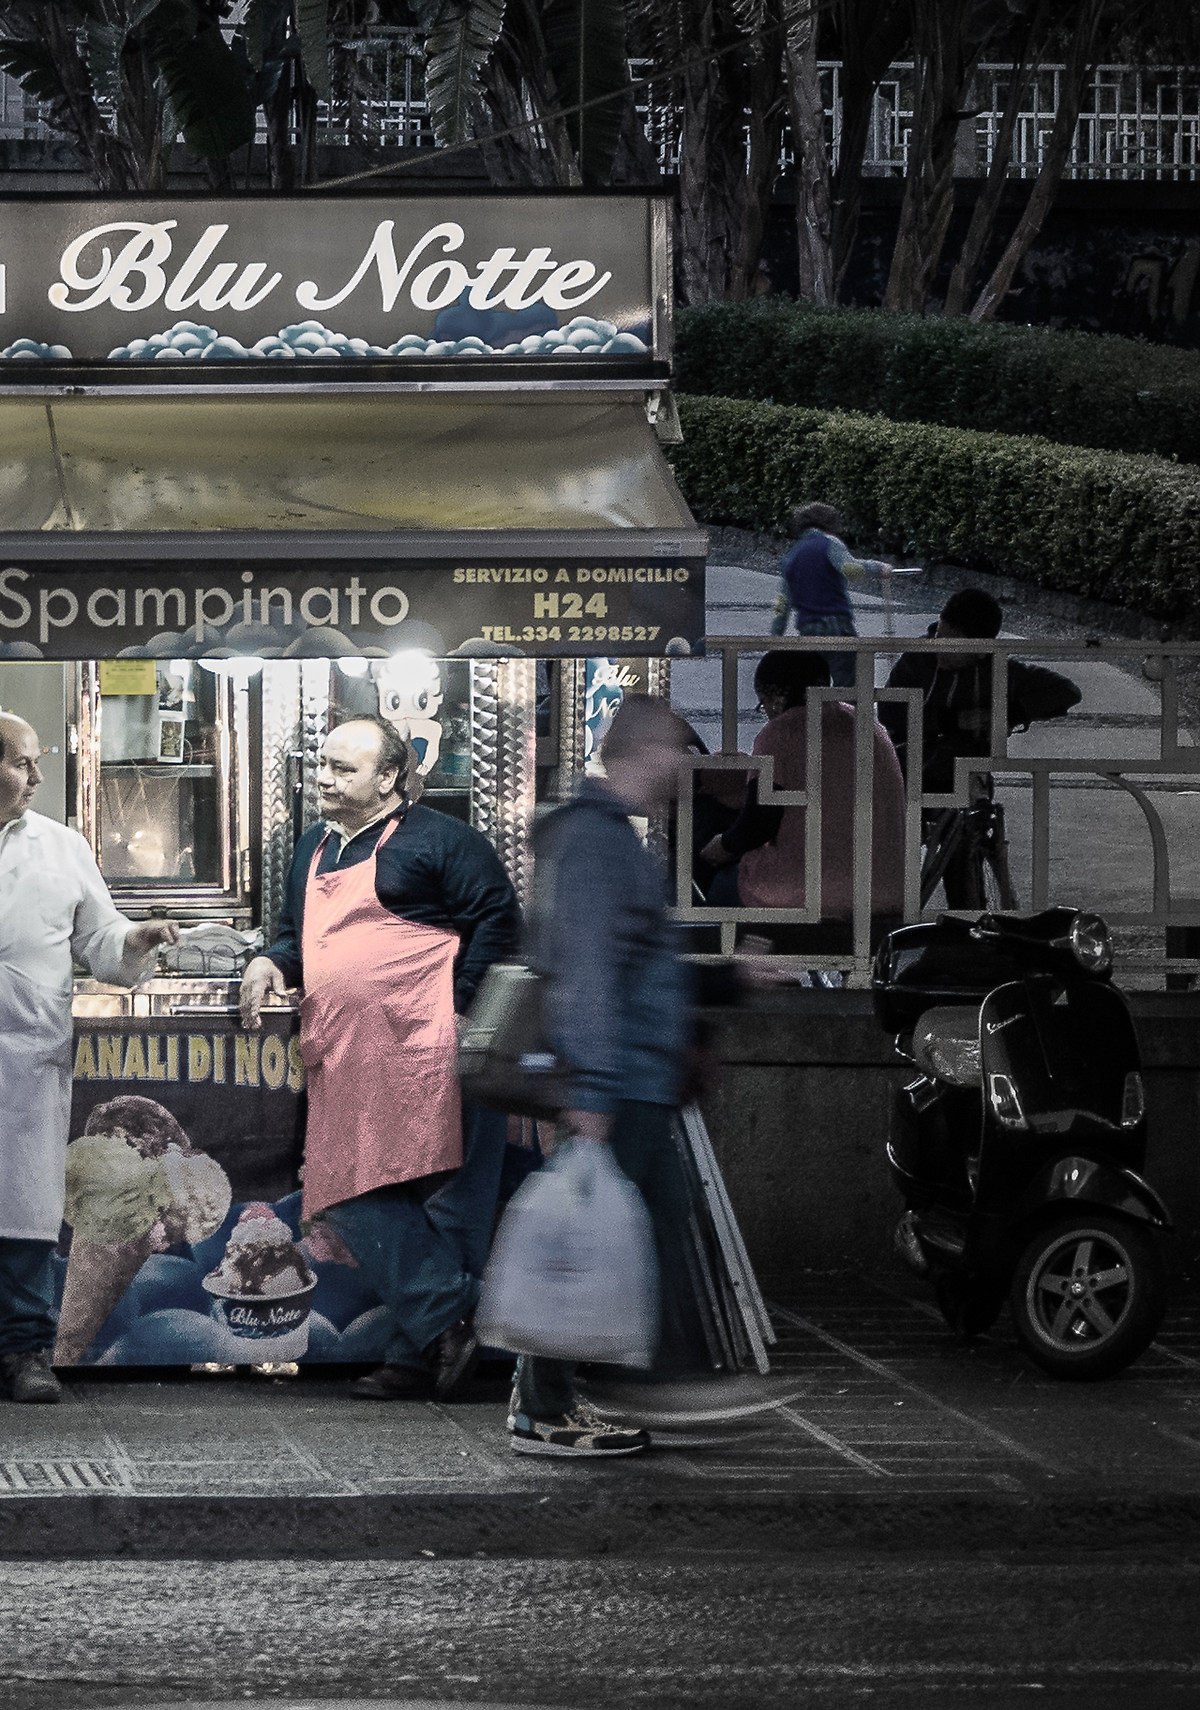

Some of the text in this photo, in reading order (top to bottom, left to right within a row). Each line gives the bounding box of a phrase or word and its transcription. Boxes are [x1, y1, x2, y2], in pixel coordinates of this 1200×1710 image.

[48, 219, 282, 312] Blu
[295, 219, 612, 312] Notte
[453, 568, 689, 583] SERVIZIO A DOMICILIO
[533, 592, 608, 618] H24
[481, 626, 660, 642] TEL.334 2298527
[592, 664, 640, 687] Blu
[188, 1034, 226, 1084] DI
[230, 1306, 302, 1327] Blu Notte
